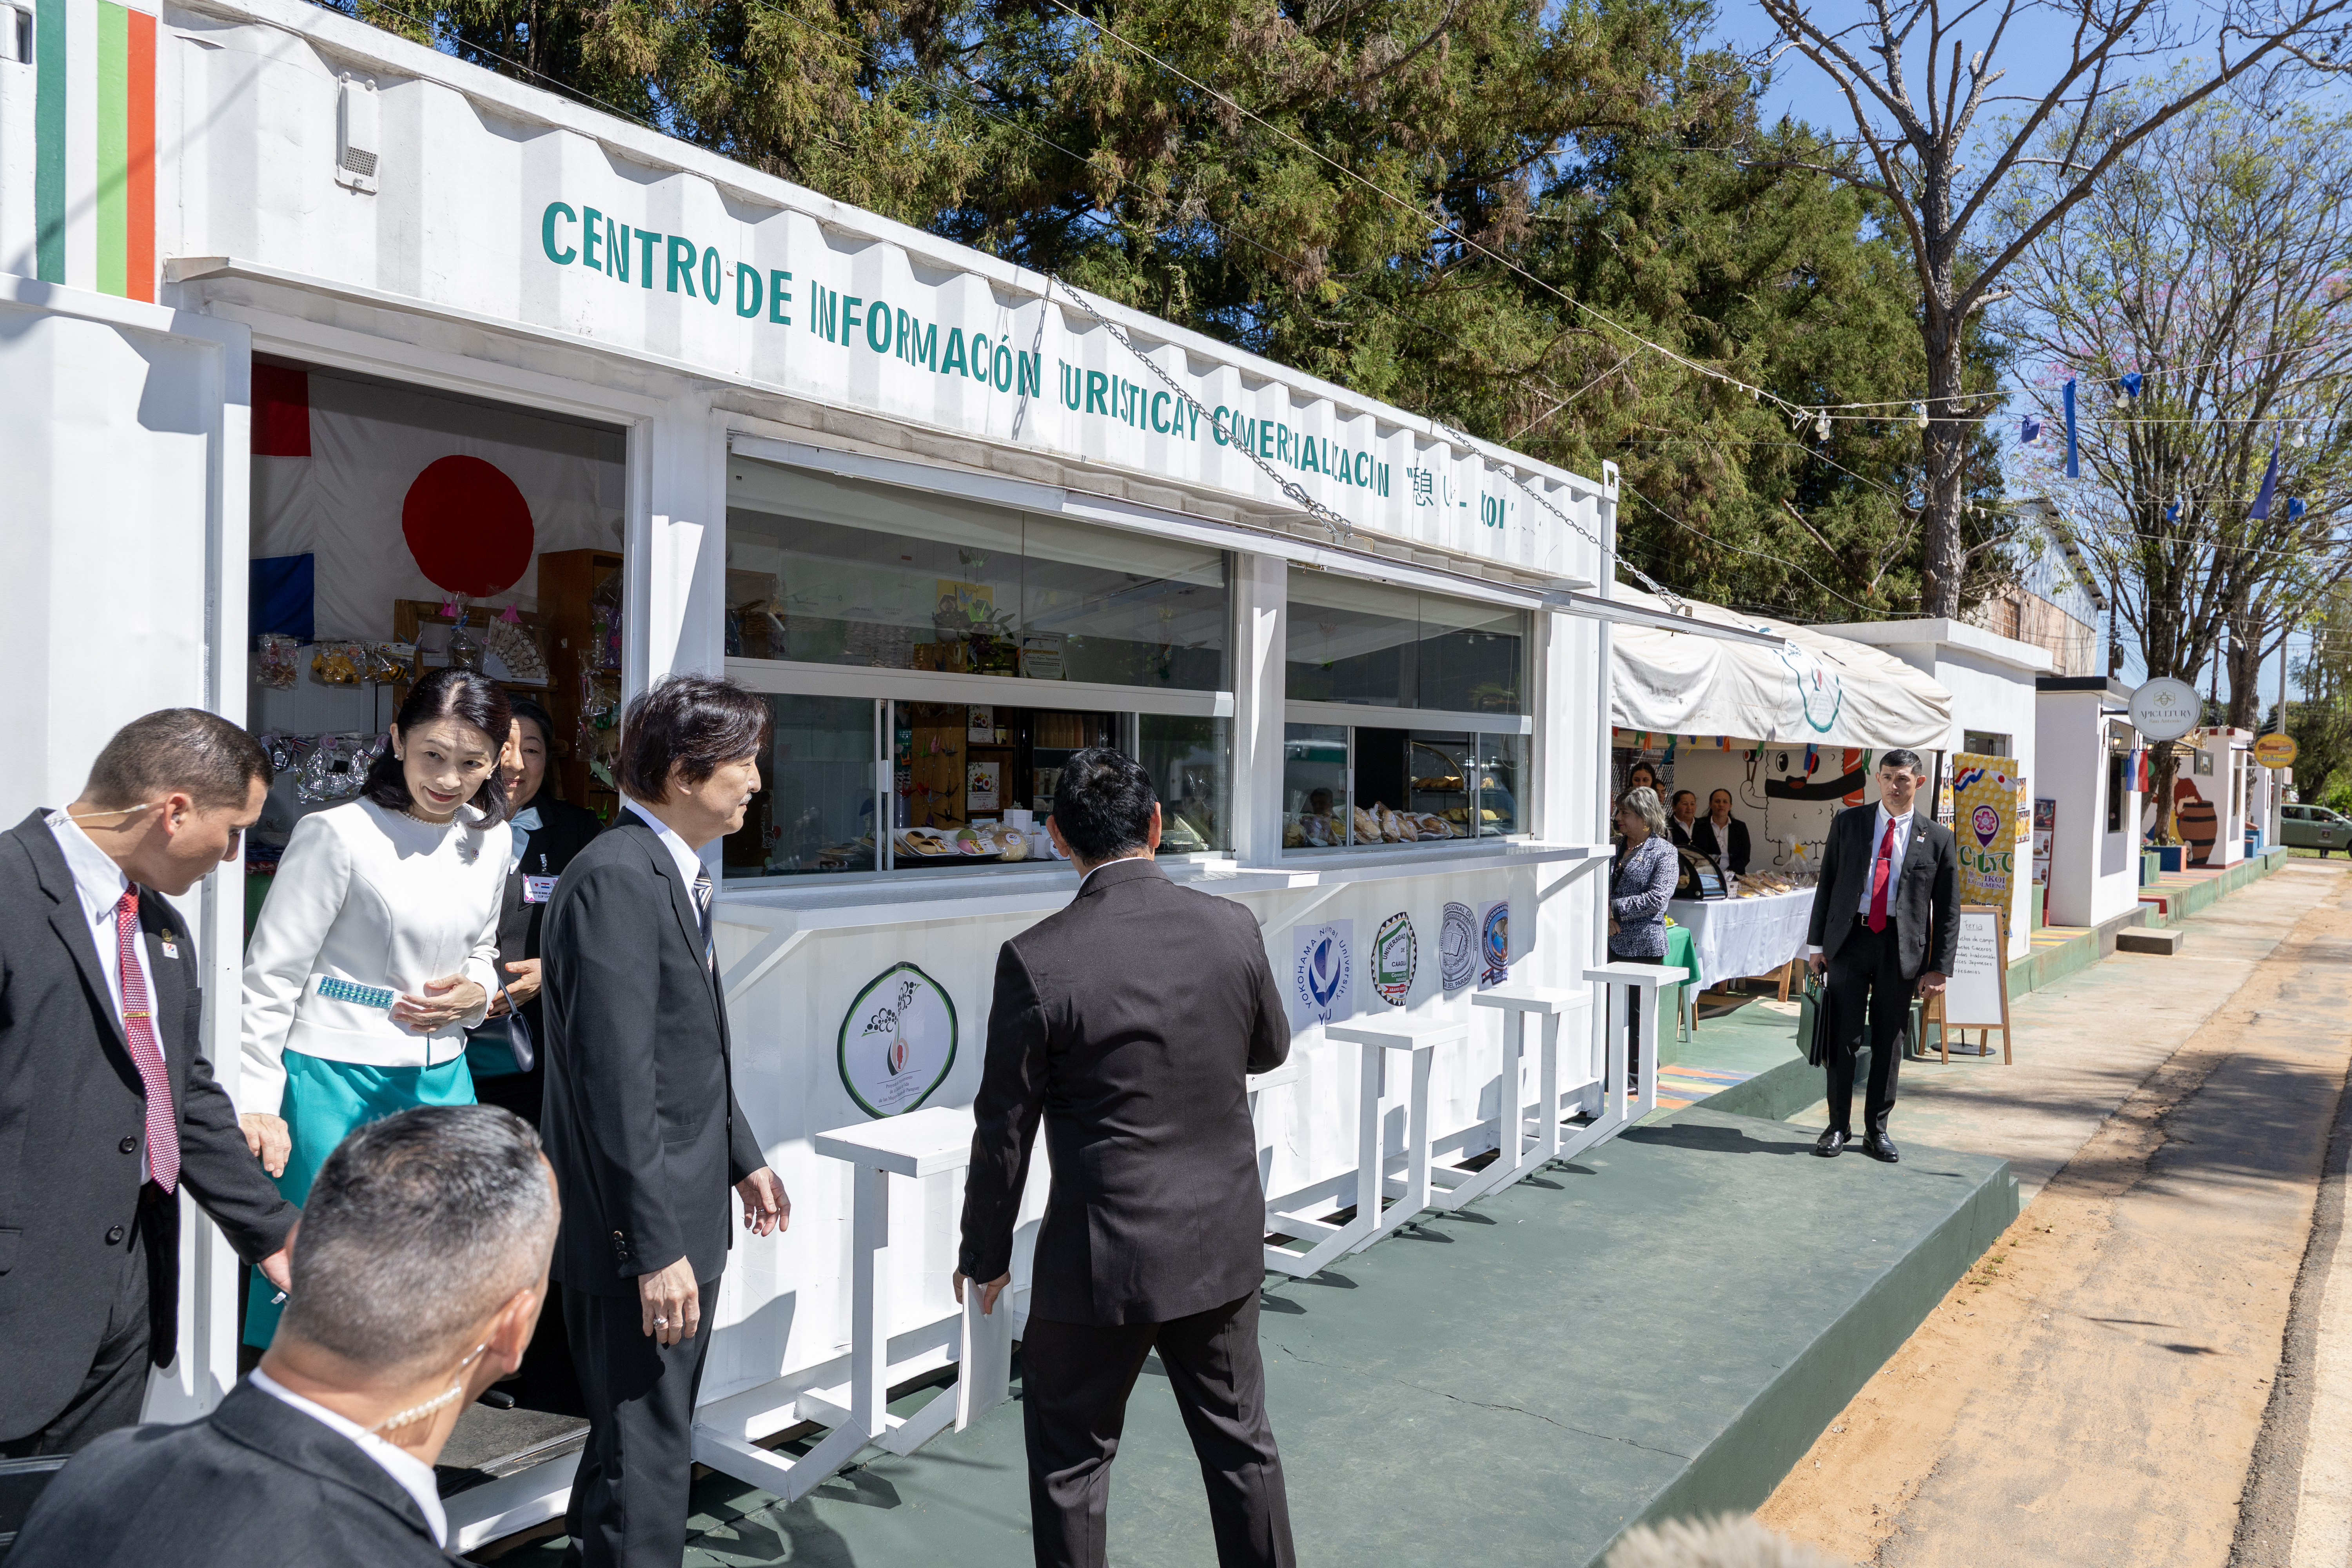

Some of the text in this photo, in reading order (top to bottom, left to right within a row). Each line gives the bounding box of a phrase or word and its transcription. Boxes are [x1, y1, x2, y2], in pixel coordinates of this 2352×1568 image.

[542, 201, 721, 305] CENTRO
[736, 261, 791, 326] DE
[811, 279, 1041, 398] INFORMACIÓN
[2140, 710, 2190, 719] APICULTURA
[1975, 881, 2006, 890] COLMENA
[1984, 875, 2006, 884] IKOI
[1444, 905, 1465, 914] NACIONAL
[1466, 910, 1472, 919] DE
[1462, 916, 1470, 926] VERO
[1964, 920, 1983, 930] Feria
[1382, 933, 1406, 960] UNIVERSIDAD
[1298, 939, 1317, 1009] YOKOHAMA
[1339, 940, 1350, 1001] University
[1455, 965, 1474, 987] PARAGUAY
